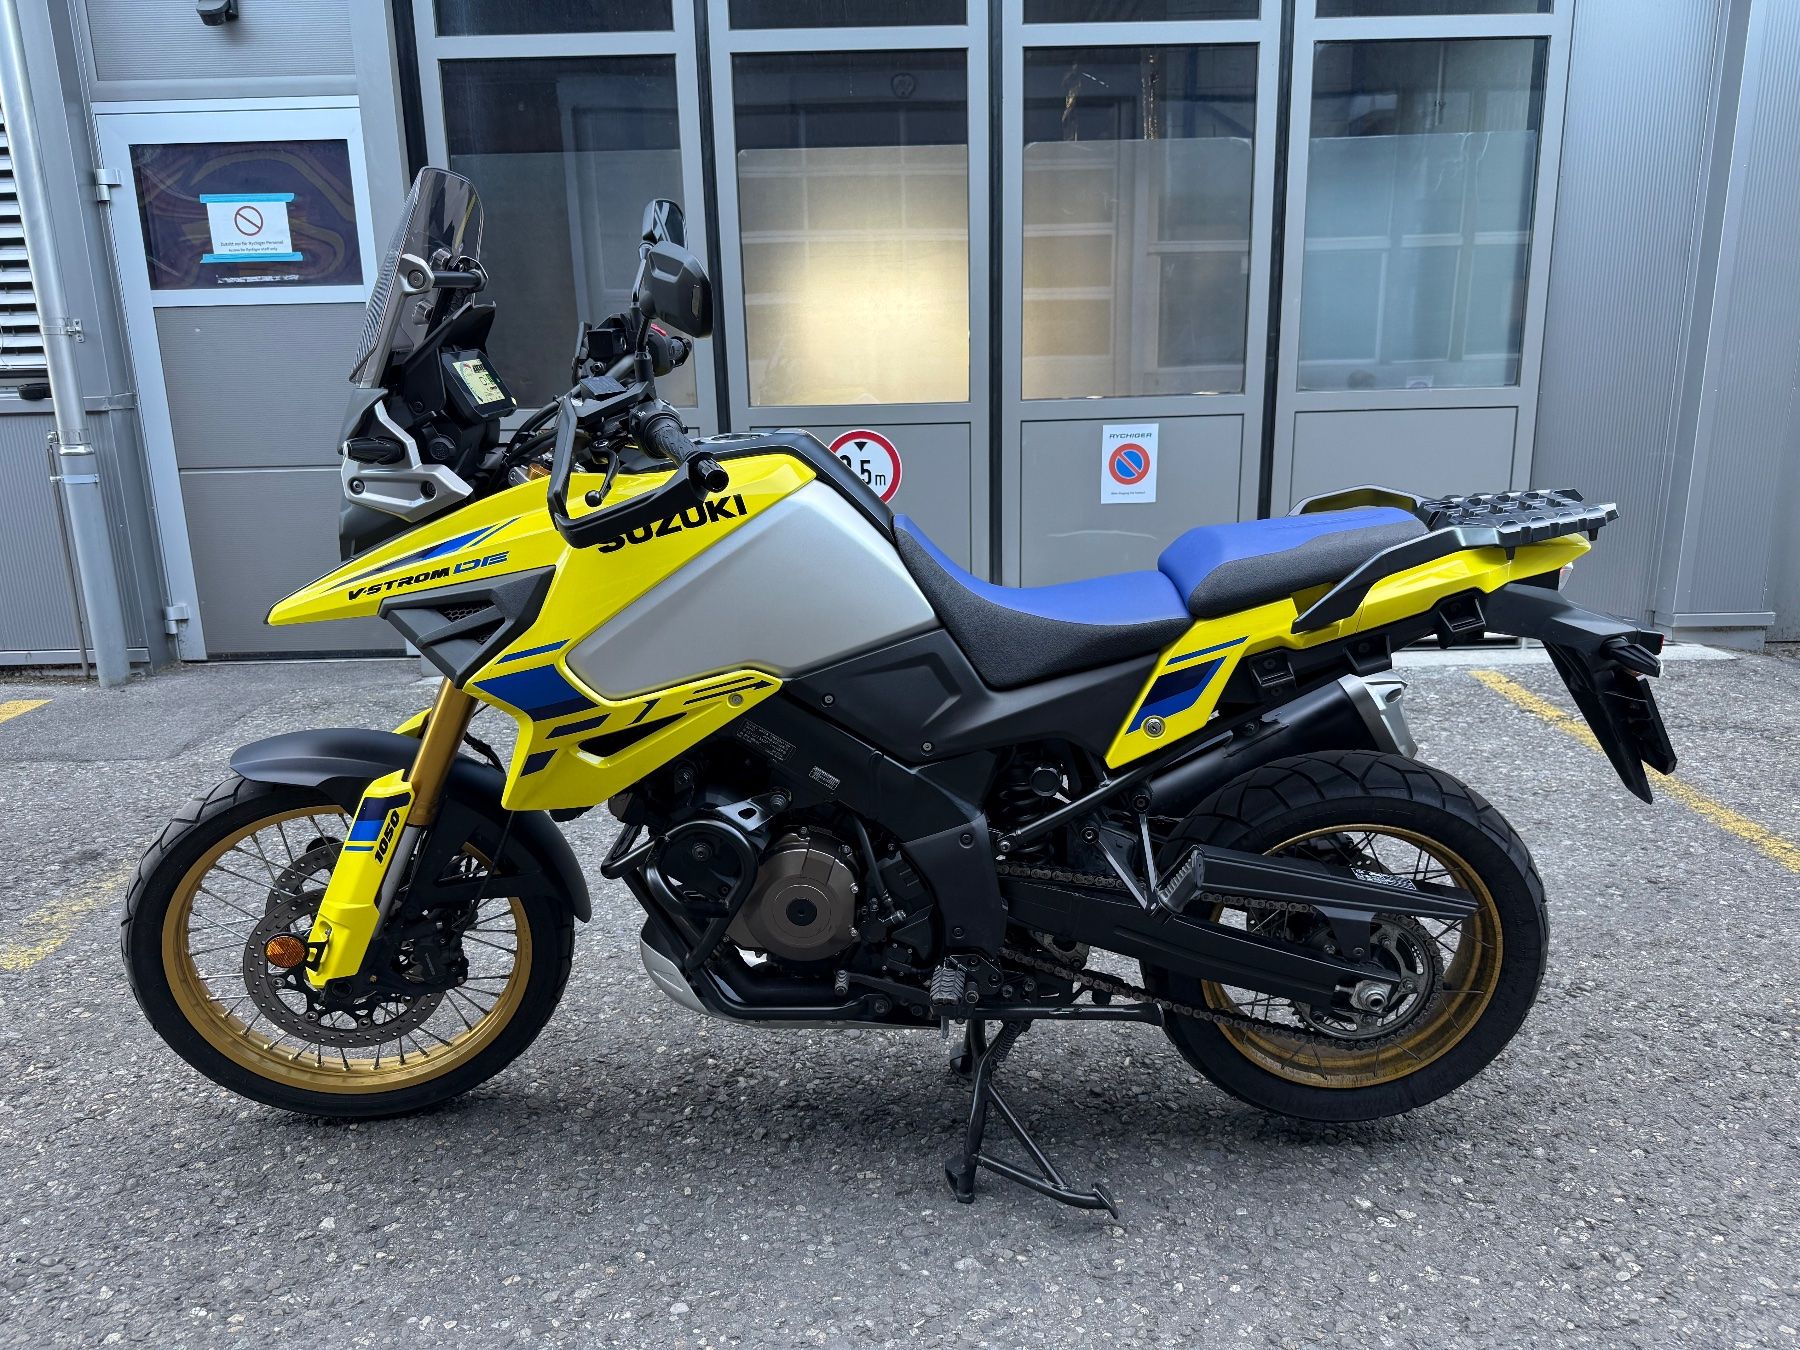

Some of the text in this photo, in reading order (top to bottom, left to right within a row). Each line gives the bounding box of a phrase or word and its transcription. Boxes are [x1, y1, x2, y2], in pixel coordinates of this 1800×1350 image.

[1109, 432, 1152, 440] RYCHIGER
[598, 493, 748, 554] SUZUKI
[453, 551, 510, 575] DE
[374, 809, 400, 865] 1050
